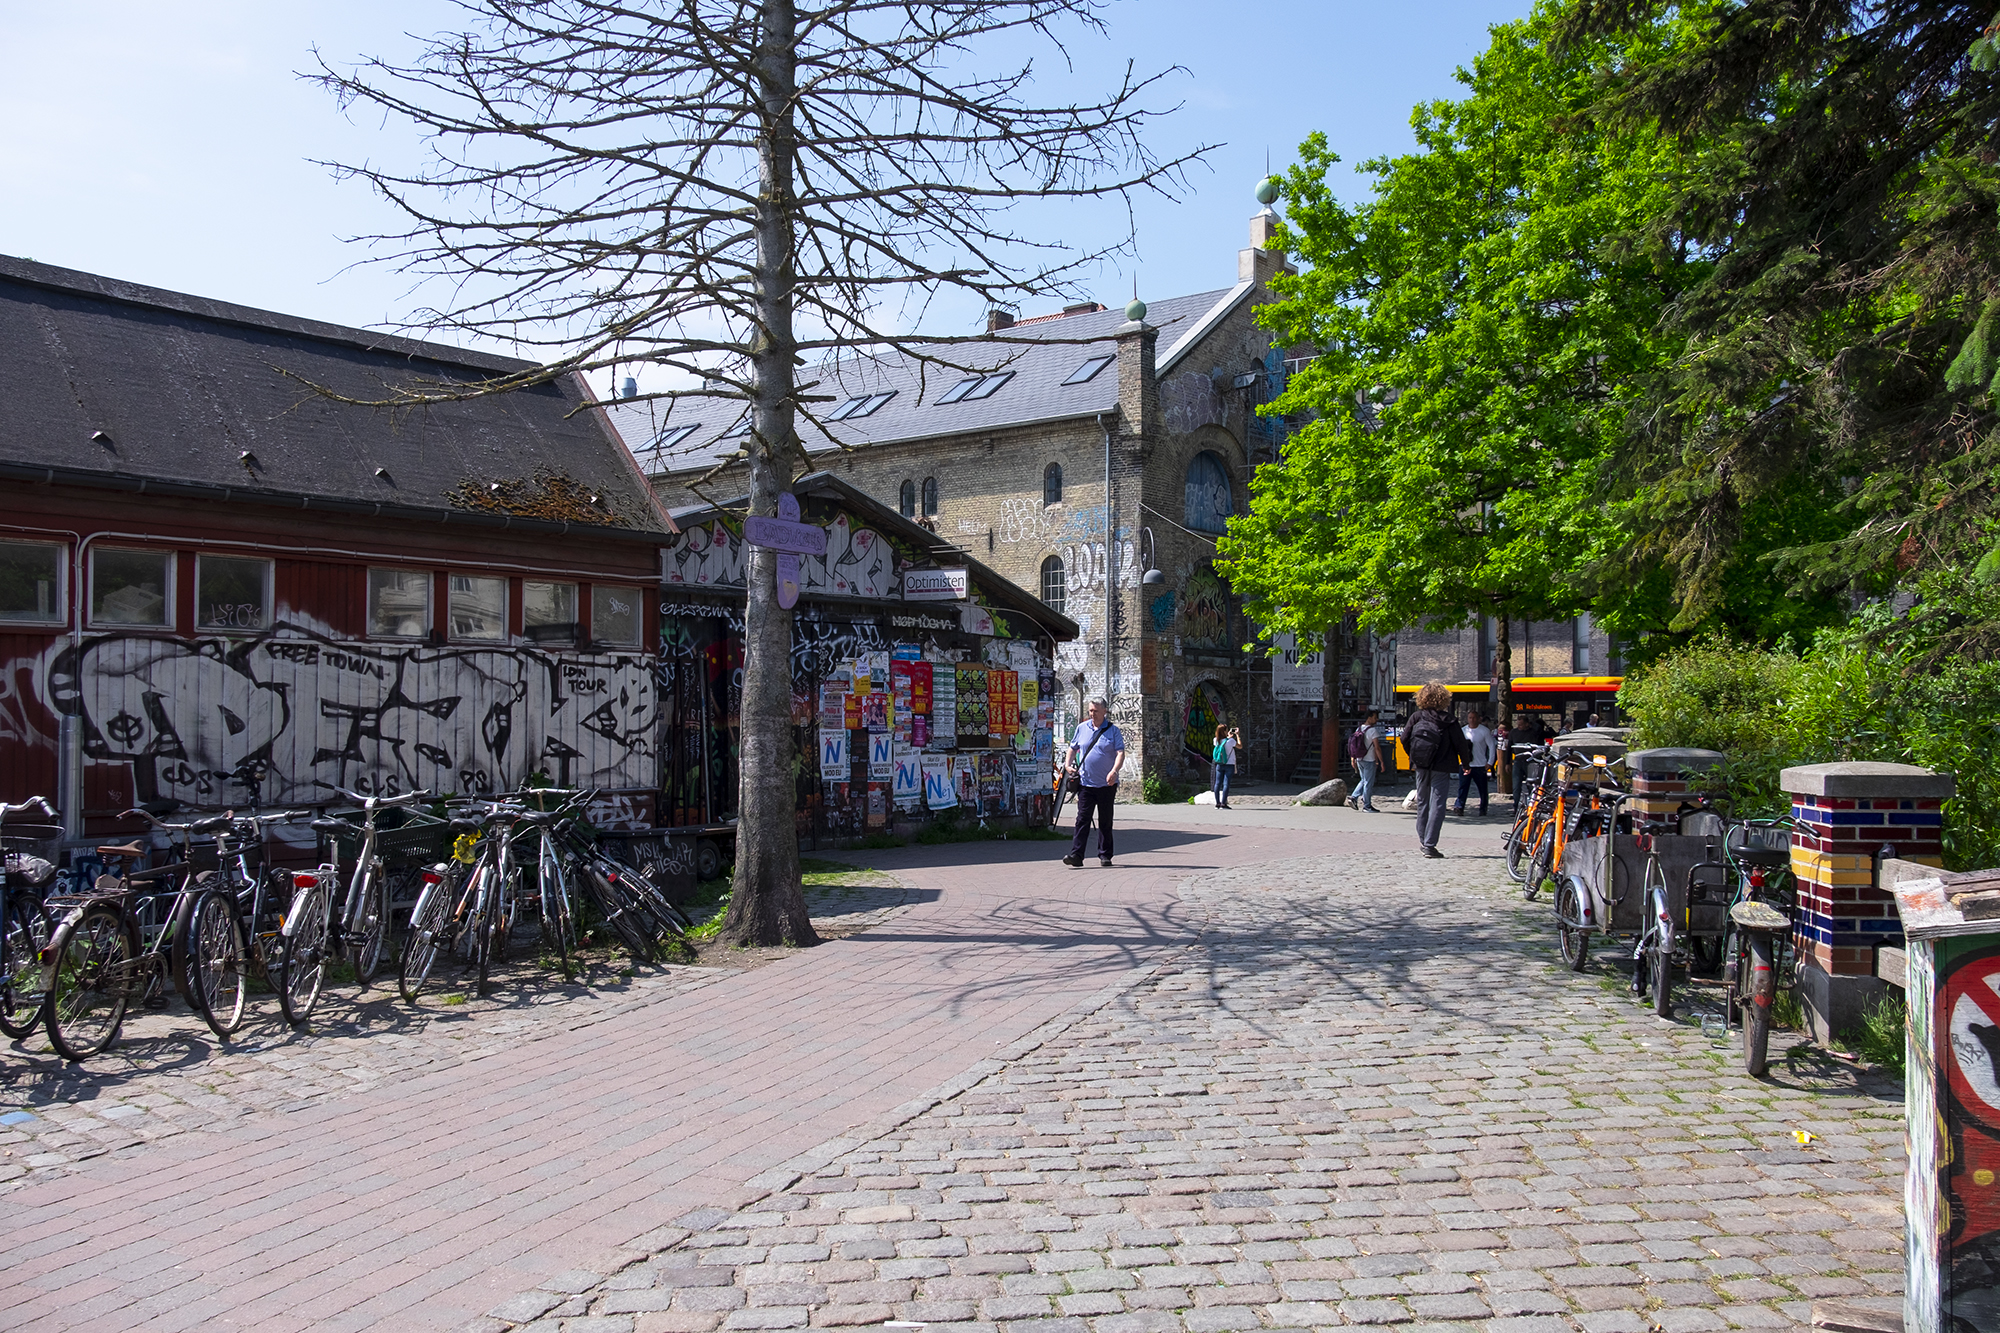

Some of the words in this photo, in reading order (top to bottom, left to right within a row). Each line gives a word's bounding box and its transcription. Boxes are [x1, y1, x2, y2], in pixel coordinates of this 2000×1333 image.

[906, 575, 965, 590] Optimisten
[265, 640, 320, 665] FREE
[321, 651, 384, 680] TOWN
[563, 665, 587, 677] LDN
[568, 678, 607, 694] TOUR
[897, 763, 920, 791] Nej
[928, 774, 950, 800] Nej
